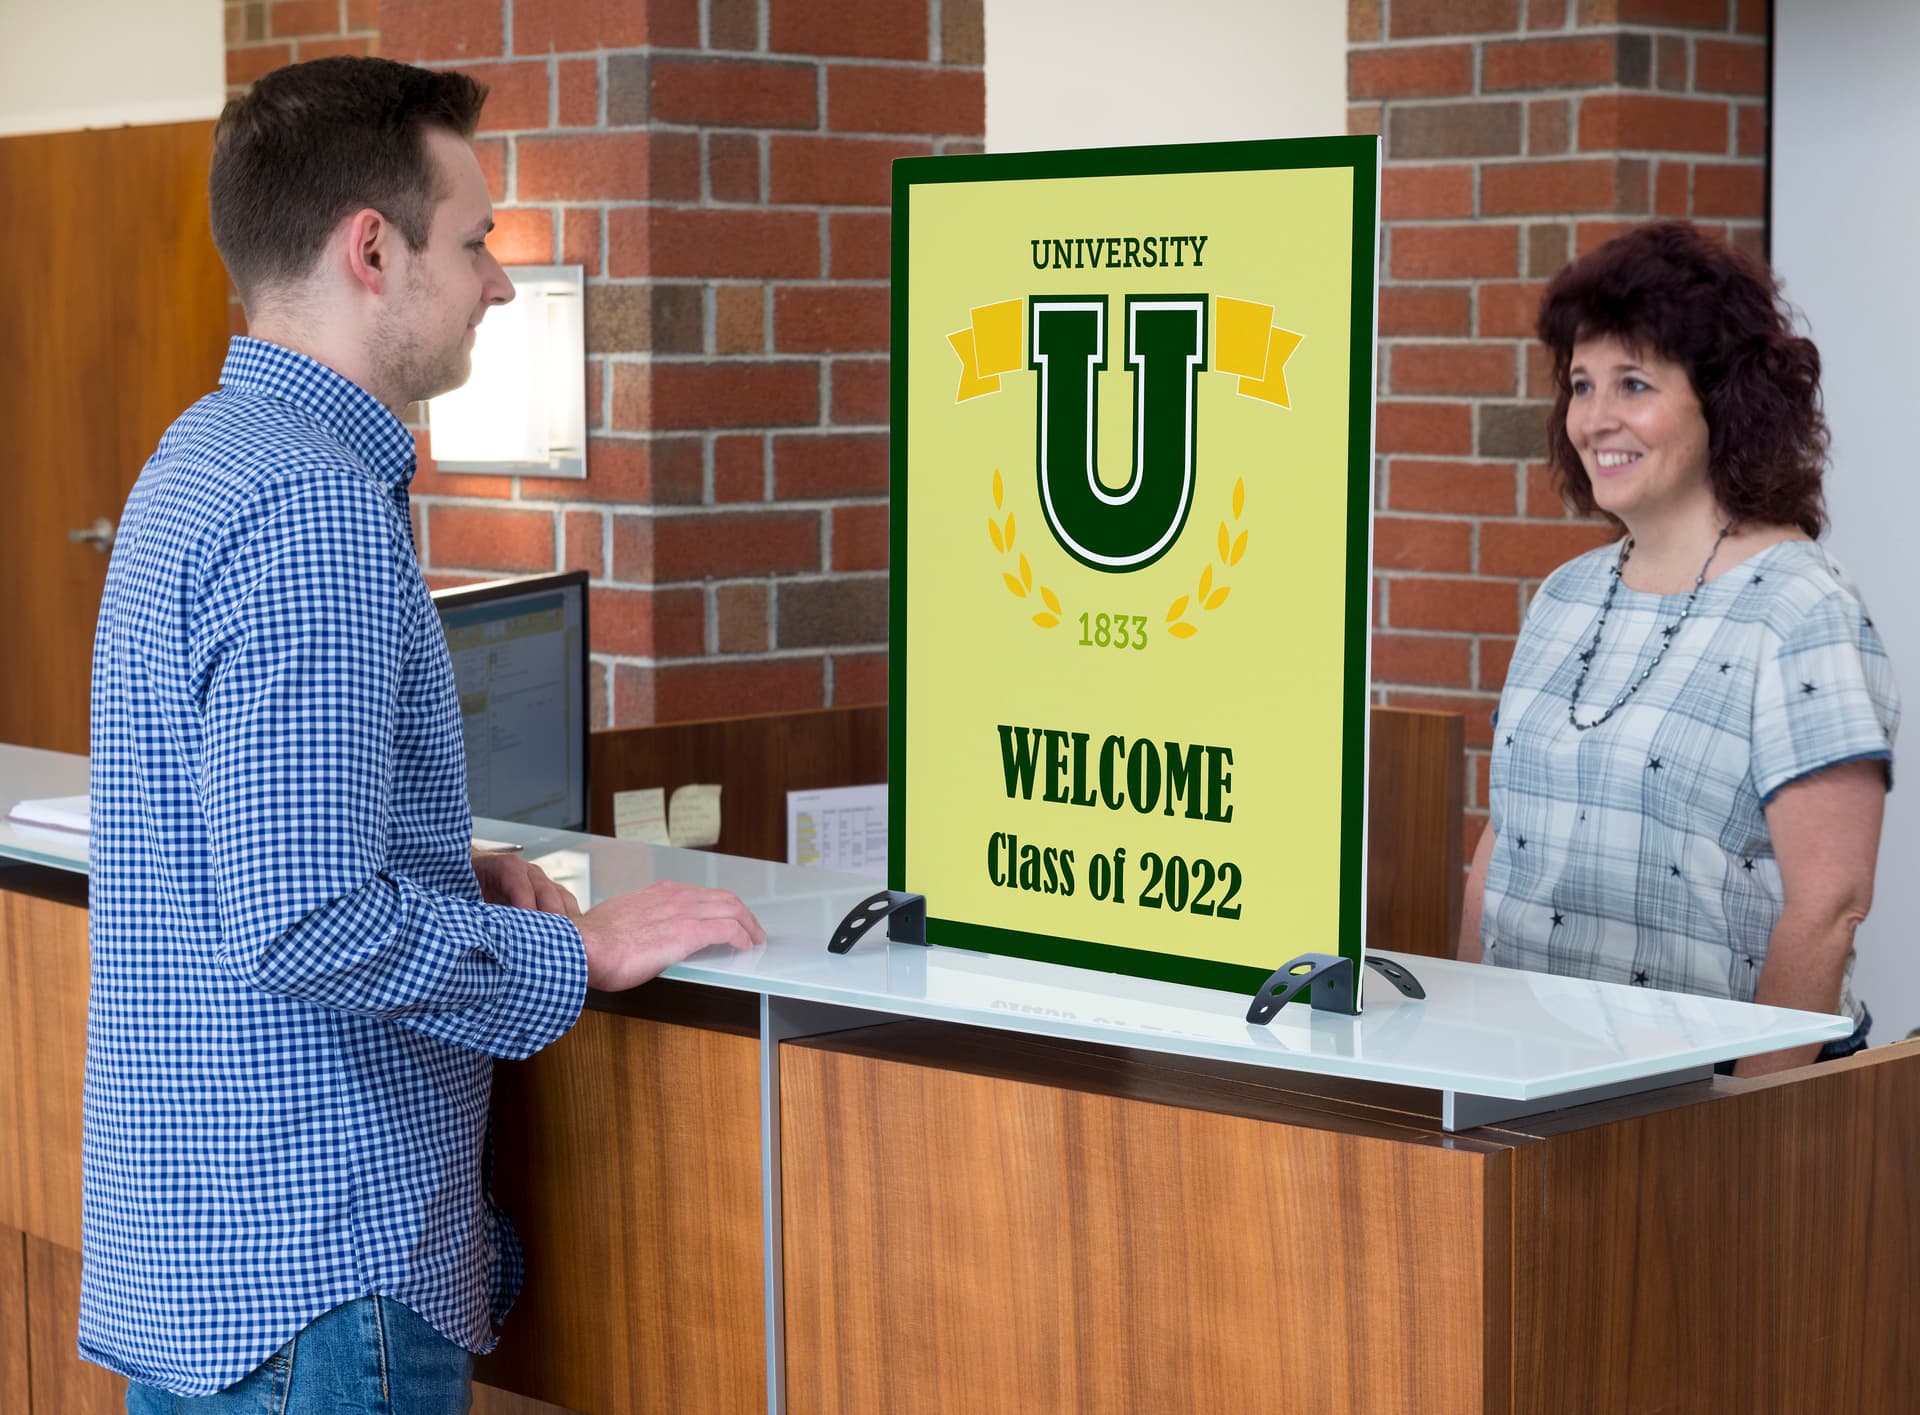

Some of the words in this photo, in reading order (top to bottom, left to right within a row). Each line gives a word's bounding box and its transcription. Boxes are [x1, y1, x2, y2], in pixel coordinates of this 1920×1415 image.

[1031, 236, 1208, 269] UNIVERSITY
[1028, 293, 1208, 573] U
[1079, 613, 1148, 650] 1833
[997, 725, 1234, 824] WELCOME
[987, 832, 1075, 897] Class
[1089, 848, 1127, 905] of
[1139, 852, 1243, 921] 2022
